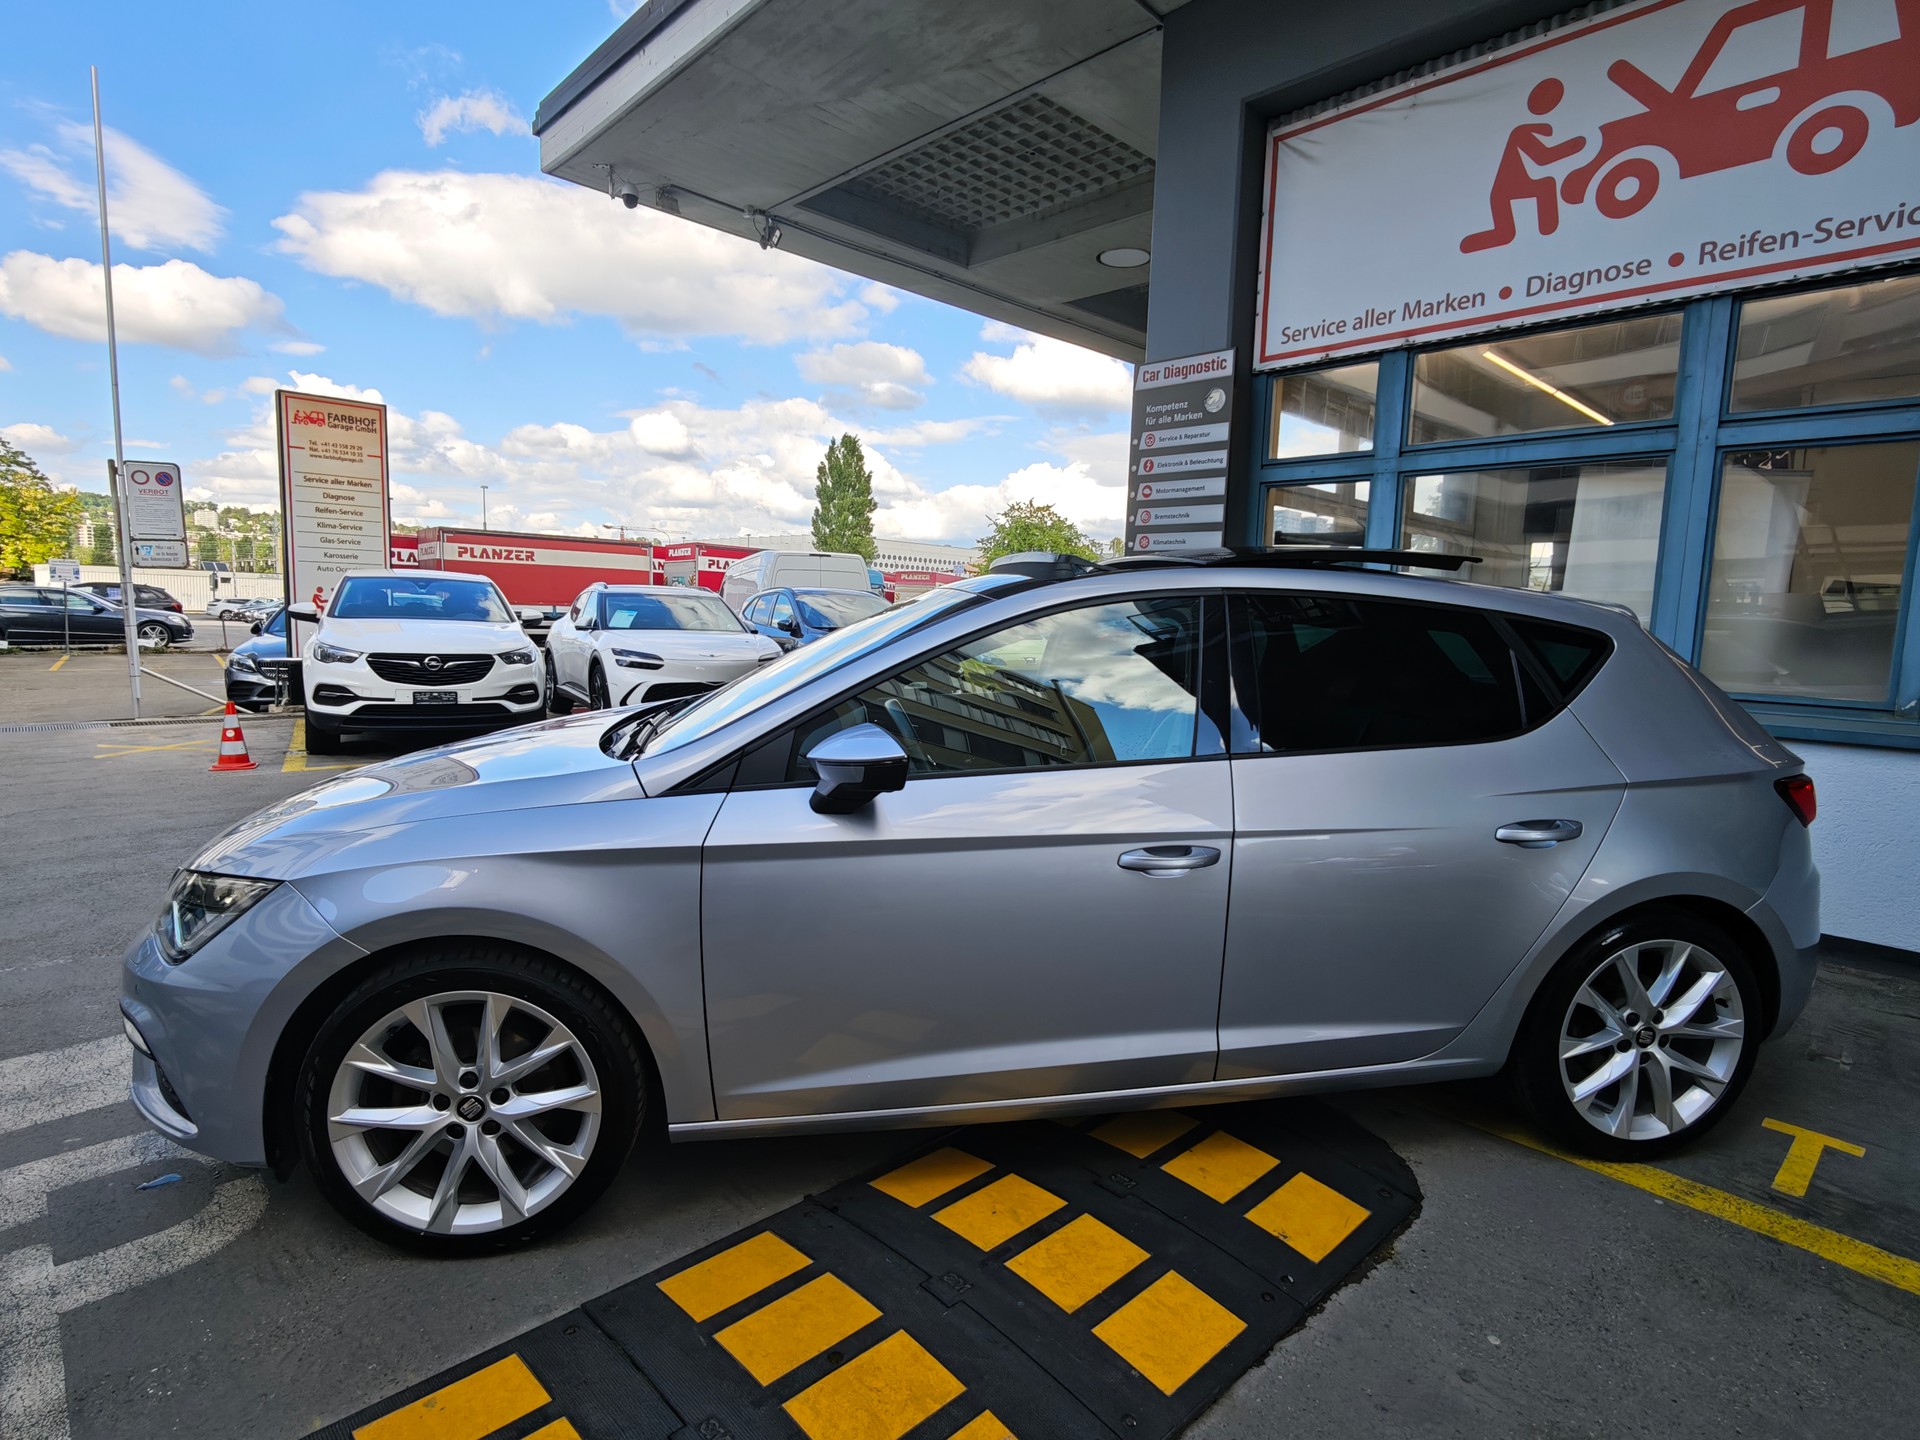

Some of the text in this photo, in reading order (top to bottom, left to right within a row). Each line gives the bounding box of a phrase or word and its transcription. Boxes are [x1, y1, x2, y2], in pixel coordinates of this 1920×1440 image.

[1525, 258, 1652, 297] Diagnose
[1281, 290, 1486, 345] Service aller Marken
[1143, 356, 1227, 383] Car Diagnostic
[1146, 401, 1189, 414] Kompetenz
[327, 412, 377, 427] FARBHOF
[1145, 411, 1203, 426] für alle Marken
[327, 421, 377, 434] Garage GmbH
[1183, 431, 1211, 440] Reparatur
[308, 439, 319, 447] Tel.
[1157, 460, 1184, 469] Elektronik
[1189, 457, 1224, 466] Beleuchtung
[303, 475, 373, 489] Service aller Marken
[1155, 485, 1206, 495] Motormanagement
[322, 492, 356, 502] Diagnose
[315, 506, 364, 517] Reifen-Service
[1154, 512, 1190, 520] Bremstechnik
[316, 521, 363, 532] Klima-Service
[319, 536, 362, 546] Glas-Service
[323, 551, 359, 560] Karosserie
[457, 546, 536, 562] PLANZER
[668, 547, 692, 557] PLANZER
[316, 565, 334, 573] Auto
